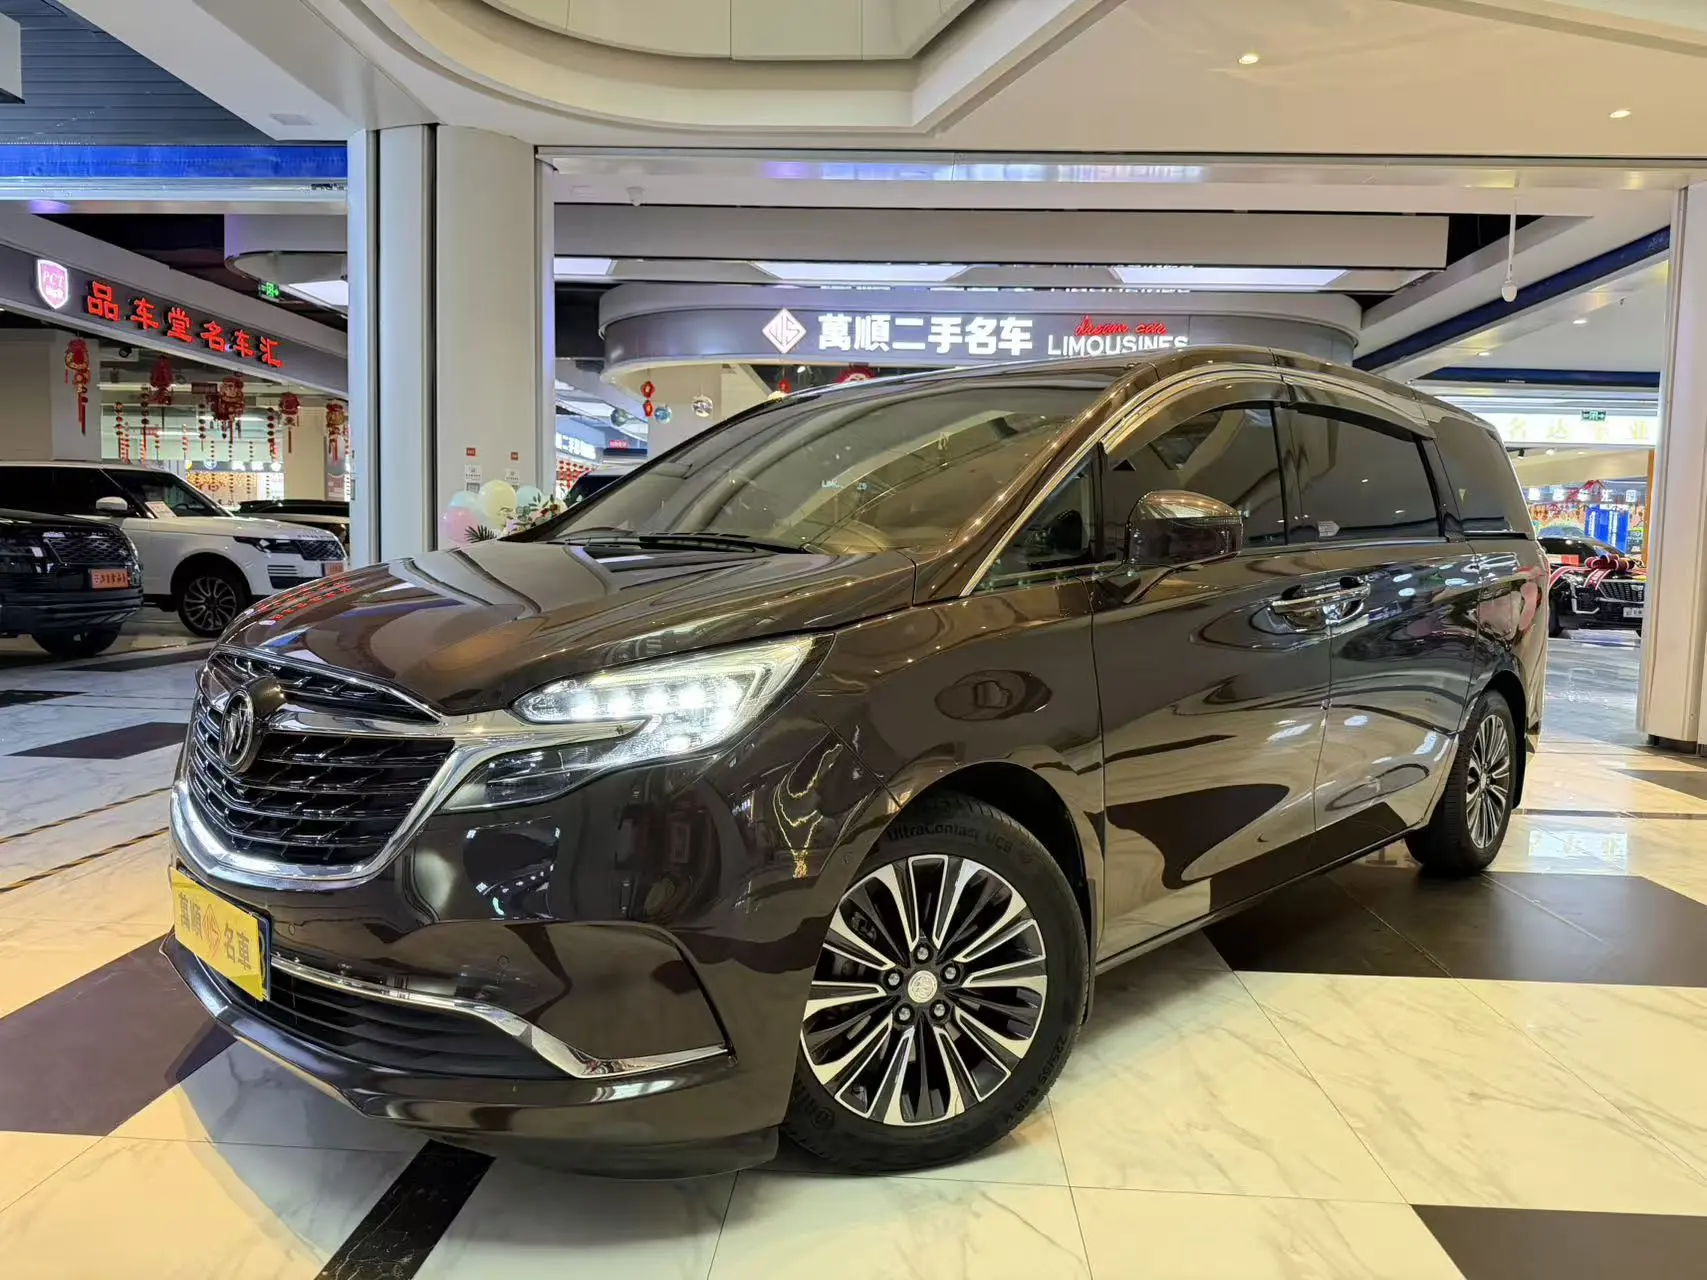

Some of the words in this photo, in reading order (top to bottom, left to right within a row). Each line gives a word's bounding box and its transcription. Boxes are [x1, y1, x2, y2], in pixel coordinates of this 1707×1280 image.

[87, 280, 284, 368] 品车堂名车汇
[818, 314, 1033, 355] 萬順二手名车
[1047, 334, 1190, 357] LIMOUSINES
